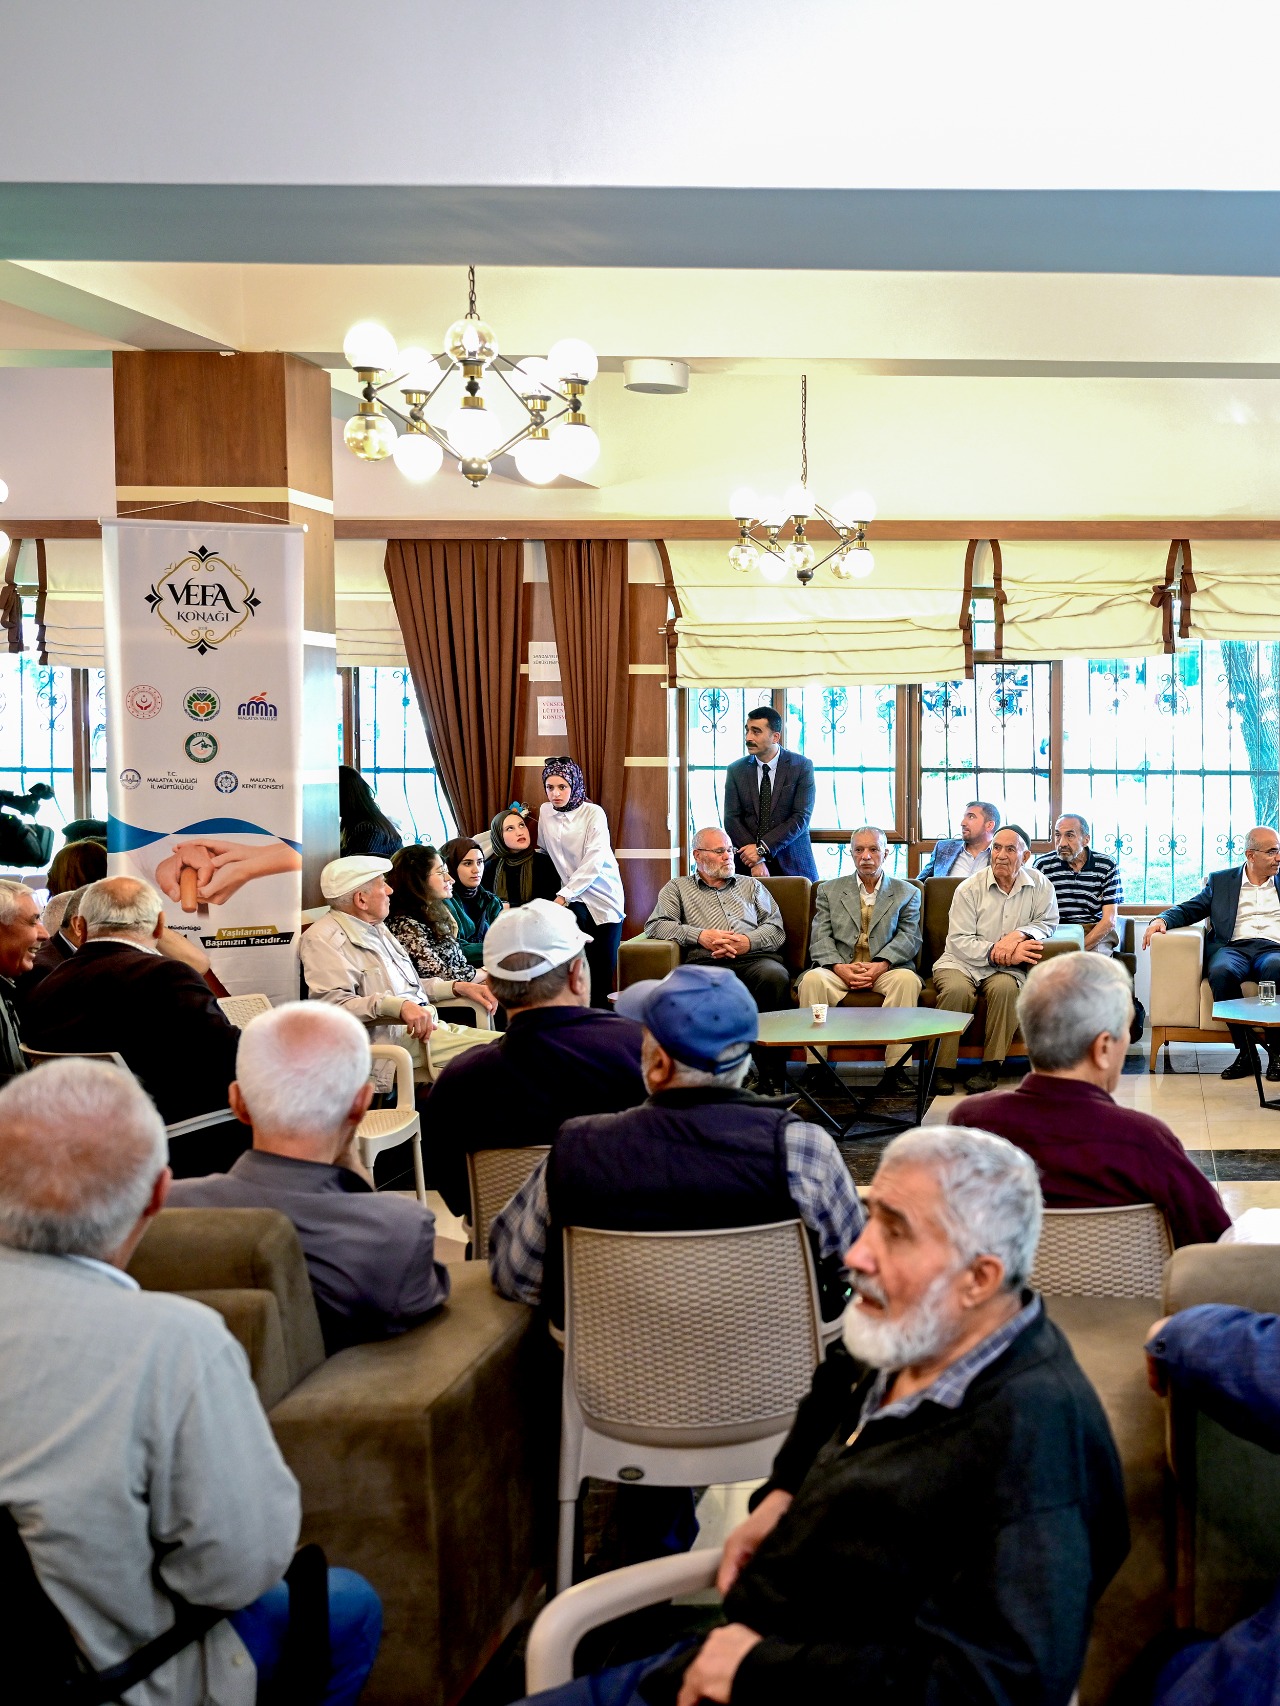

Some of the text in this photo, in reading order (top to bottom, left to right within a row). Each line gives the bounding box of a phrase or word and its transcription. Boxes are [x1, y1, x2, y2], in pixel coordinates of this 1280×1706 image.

[166, 577, 241, 614] VEFA
[177, 610, 229, 623] KONAĞI
[157, 783, 194, 791] MÜFTÜLÜĞÜ
[220, 928, 273, 939] Yaşlılarımız
[205, 938, 247, 949] Başımızın
